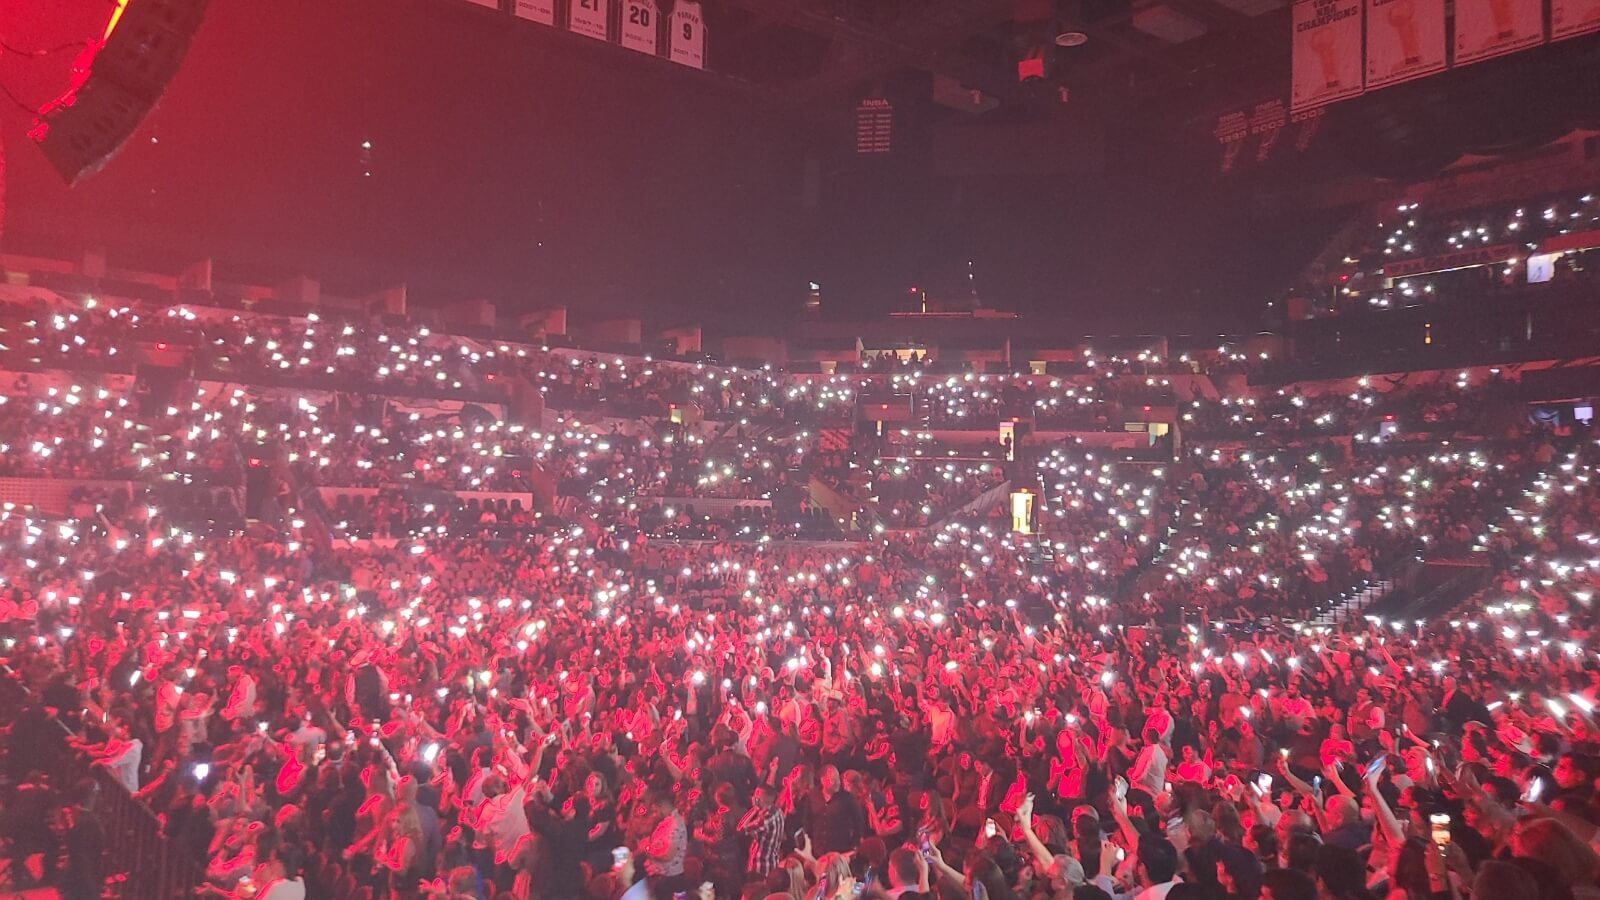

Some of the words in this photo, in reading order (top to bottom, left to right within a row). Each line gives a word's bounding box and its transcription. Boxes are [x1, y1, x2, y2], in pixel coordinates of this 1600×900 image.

[630, 5, 649, 27] 20
[1297, 5, 1358, 32] CHAMPIONS
[683, 23, 692, 40] 9
